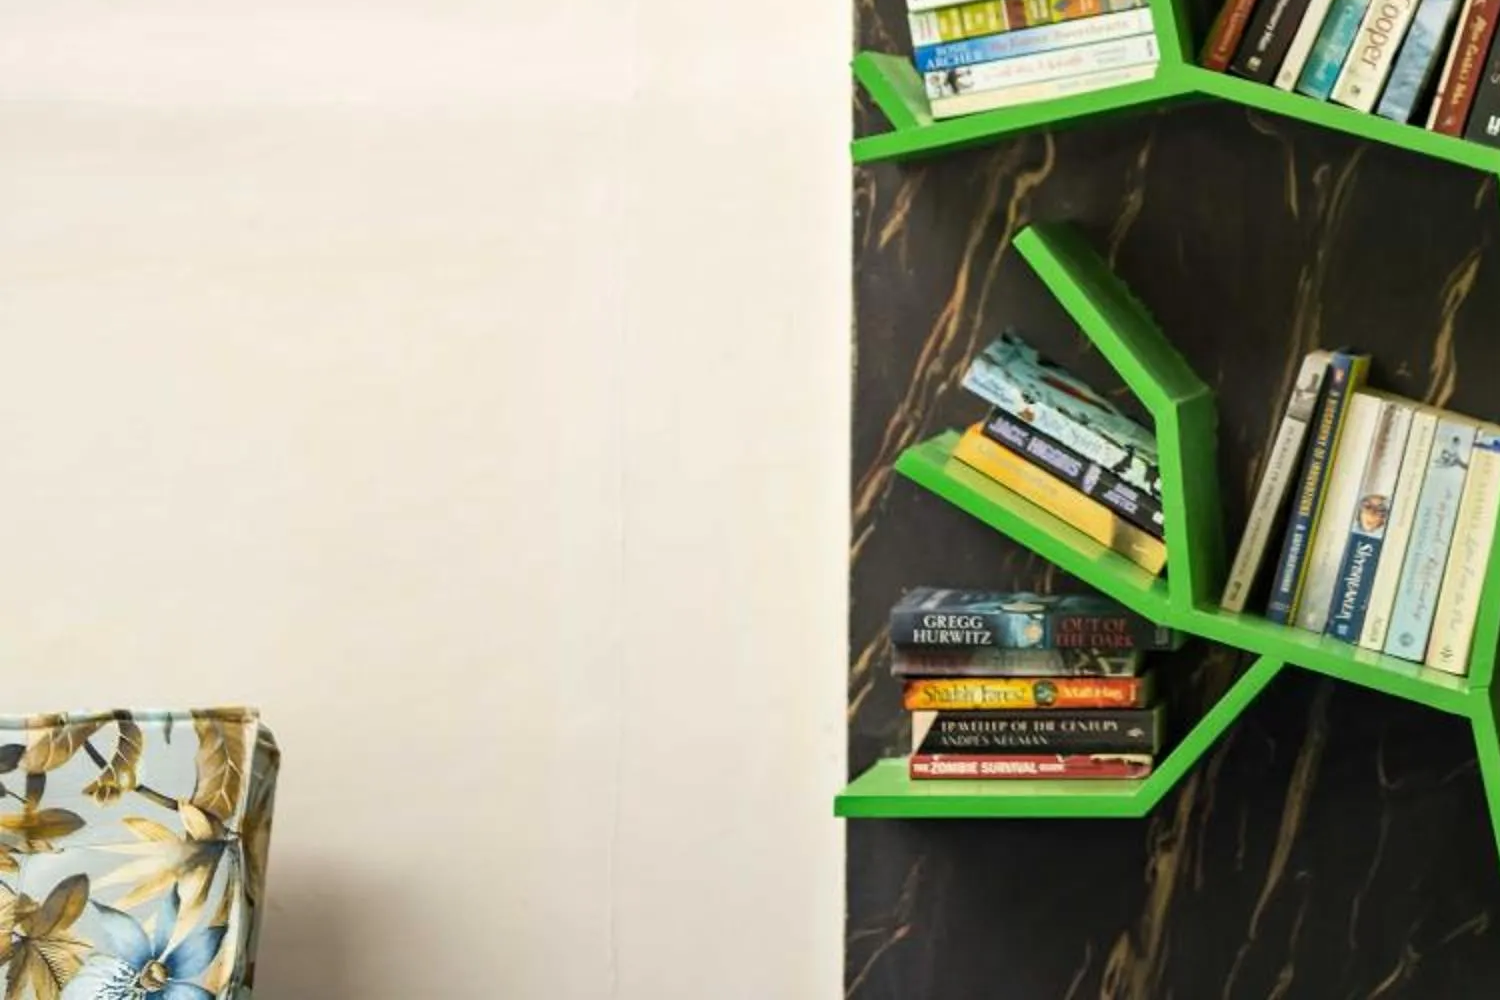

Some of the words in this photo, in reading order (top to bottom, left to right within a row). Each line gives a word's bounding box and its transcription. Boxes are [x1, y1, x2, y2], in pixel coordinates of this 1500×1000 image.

[922, 614, 983, 629] GREGG
[912, 628, 992, 645] HURWITZ
[1010, 719, 1031, 731] OF
[1033, 719, 1055, 731] THE
[1060, 719, 1119, 732] CENTURY
[930, 760, 979, 774] ZOMBIE
[980, 761, 1037, 773] SURVIVAL
